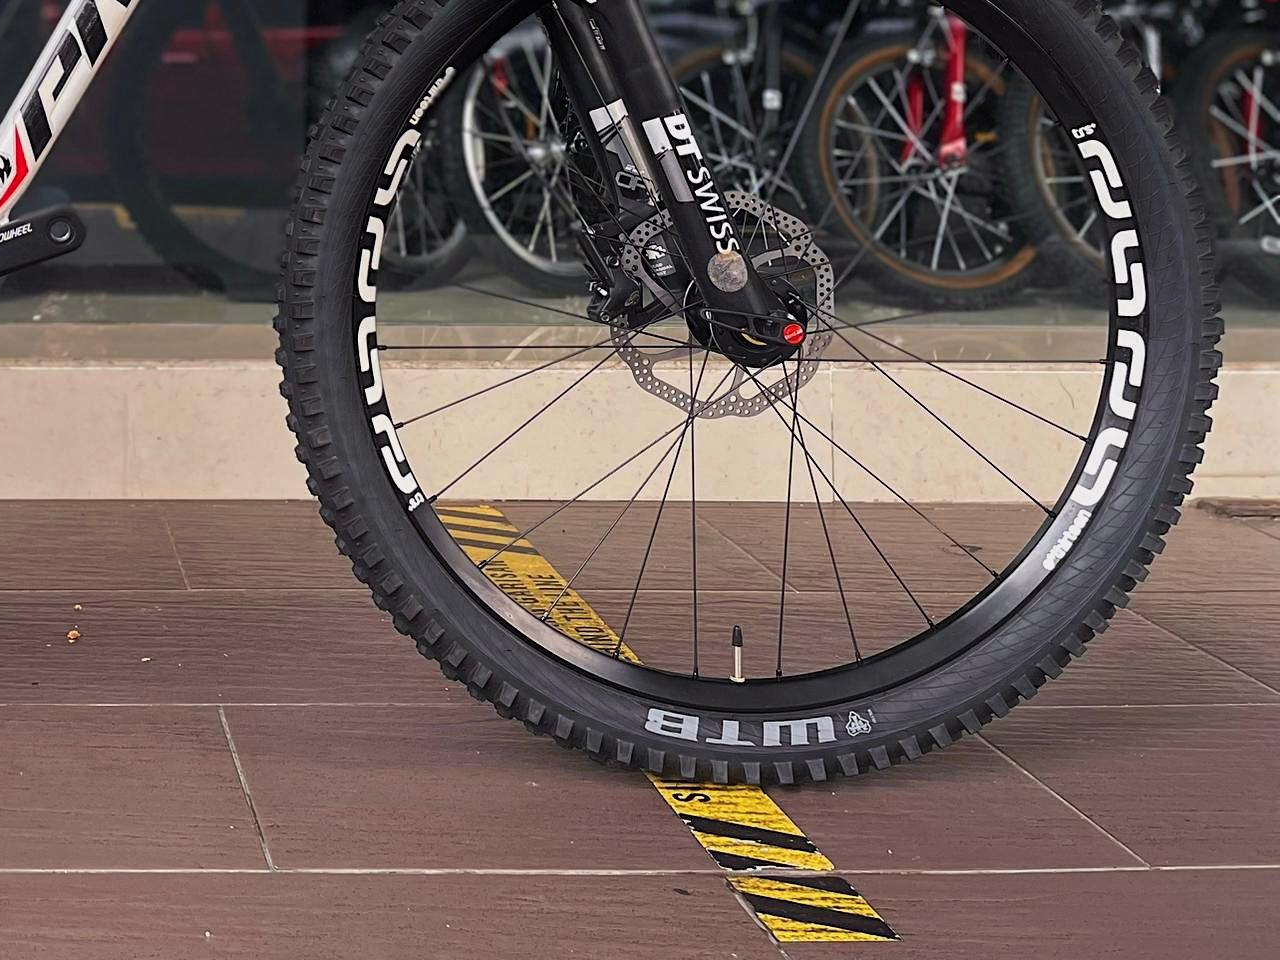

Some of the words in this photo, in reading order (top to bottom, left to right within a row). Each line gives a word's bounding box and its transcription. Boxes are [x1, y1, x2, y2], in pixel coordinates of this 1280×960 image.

[663, 113, 703, 161] DT
[686, 165, 741, 255] SWISS
[644, 707, 837, 746] WTB
